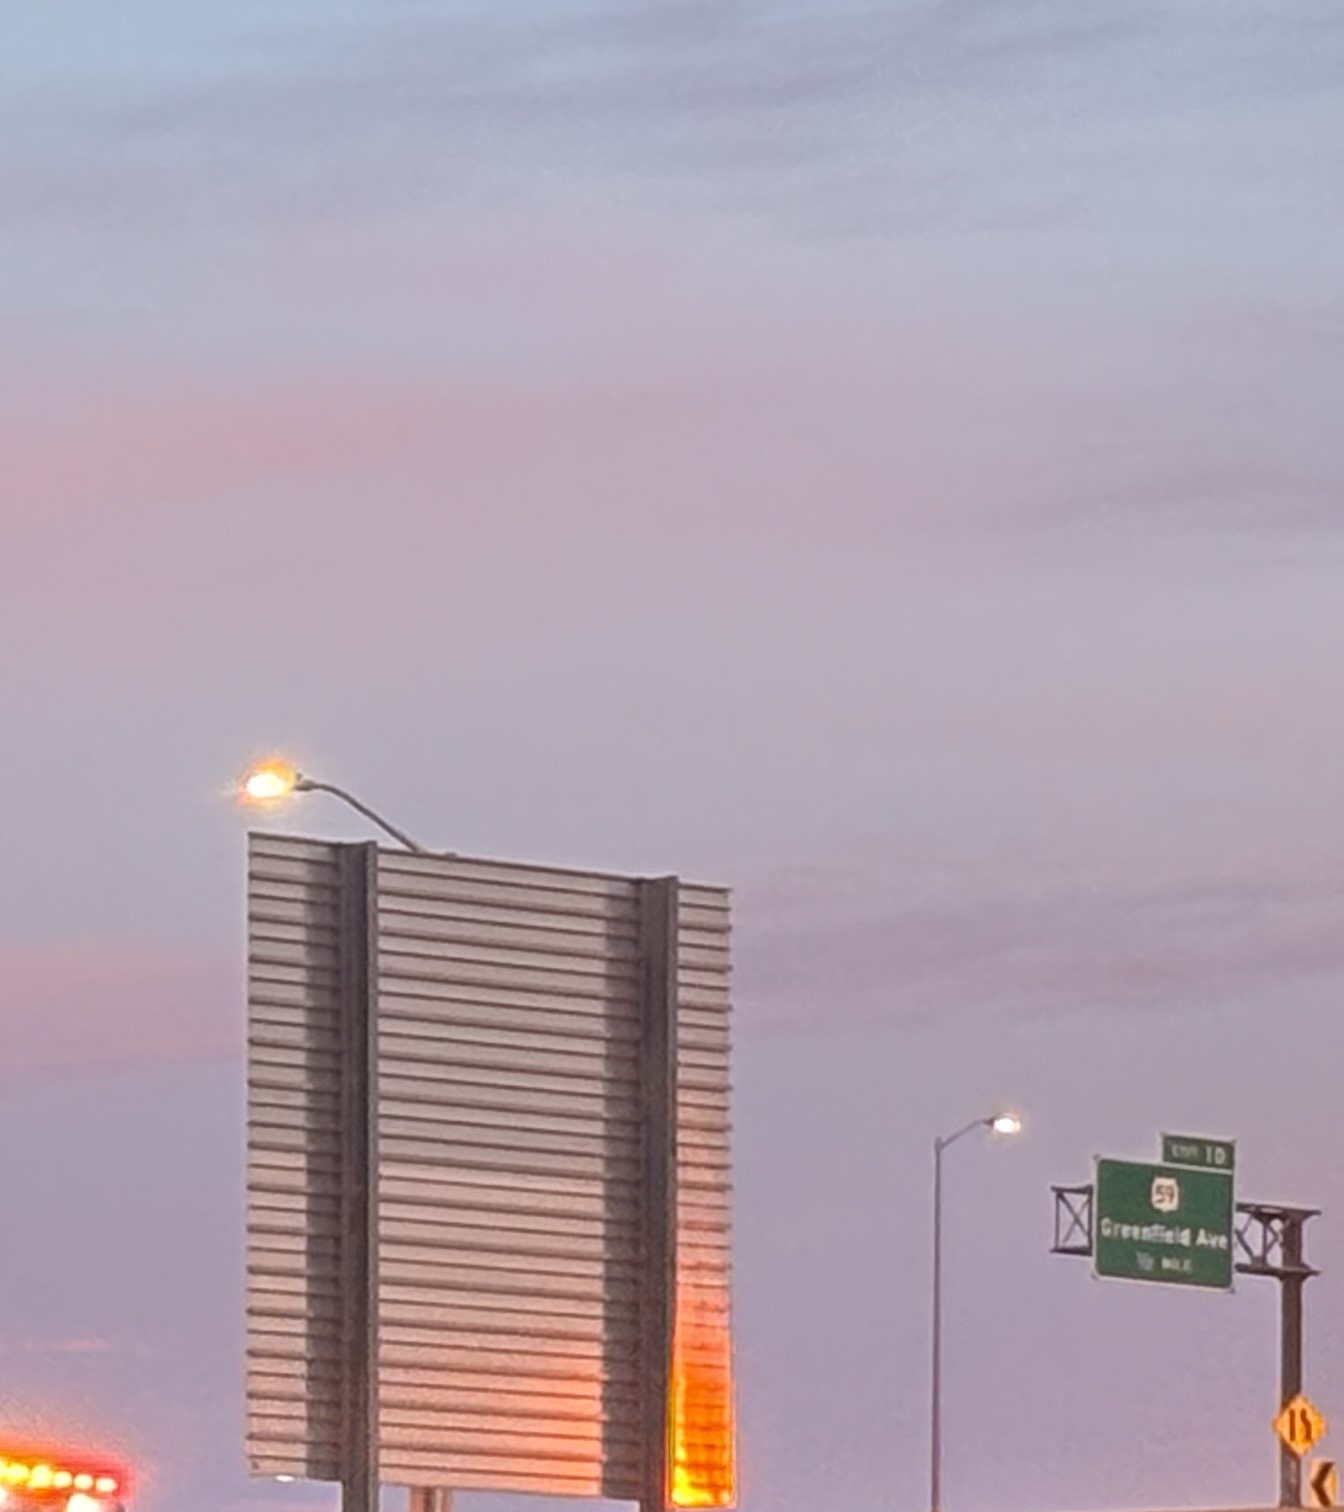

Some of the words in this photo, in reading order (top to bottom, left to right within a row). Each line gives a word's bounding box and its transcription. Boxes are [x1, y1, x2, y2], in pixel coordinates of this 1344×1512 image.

[1155, 1184, 1175, 1205] 59
[1100, 1216, 1191, 1247] Greenfield
[1196, 1227, 1228, 1250] Ave
